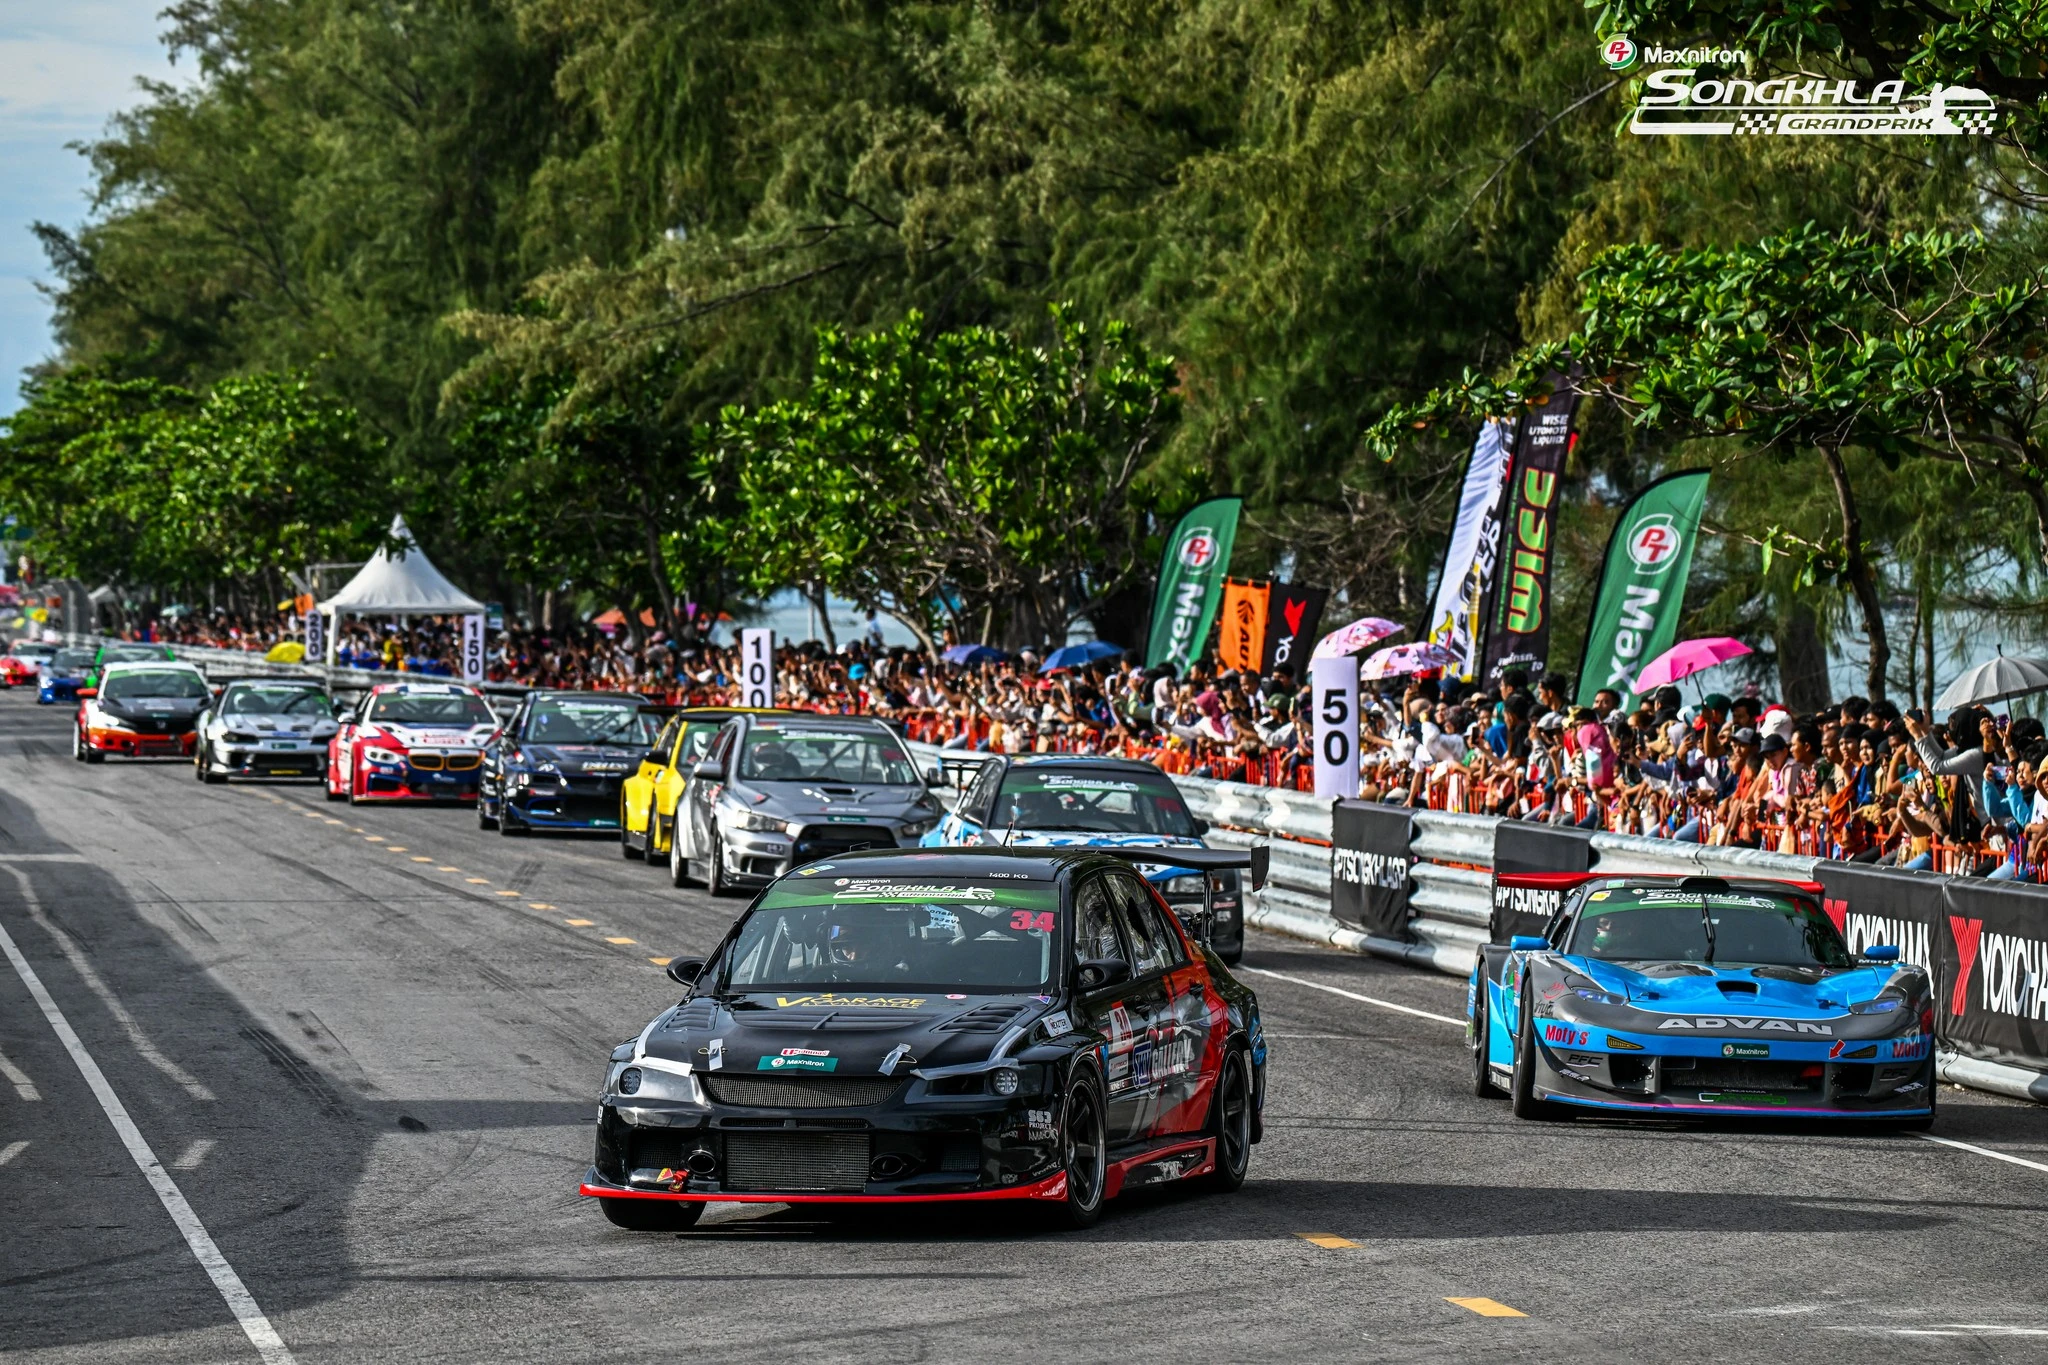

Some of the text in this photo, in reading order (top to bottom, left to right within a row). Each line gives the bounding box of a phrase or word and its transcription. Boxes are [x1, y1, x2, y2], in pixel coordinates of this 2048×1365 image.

[1188, 537, 1210, 564] PT
[1640, 528, 1669, 562] PT
[308, 612, 320, 657] 200
[467, 620, 480, 675] 150
[1274, 635, 1294, 667] YO
[749, 636, 766, 708] 100
[1321, 688, 1350, 767] 50
[845, 883, 956, 893] SONGKHLA
[1009, 910, 1056, 933] 34
[1545, 1024, 1591, 1045] Moty's
[1657, 1017, 1833, 1036] ADVAN
[786, 1059, 825, 1067] Maxnitron
[1568, 1054, 1603, 1065] PFC
[1736, 1048, 1768, 1056] Maxnitron
